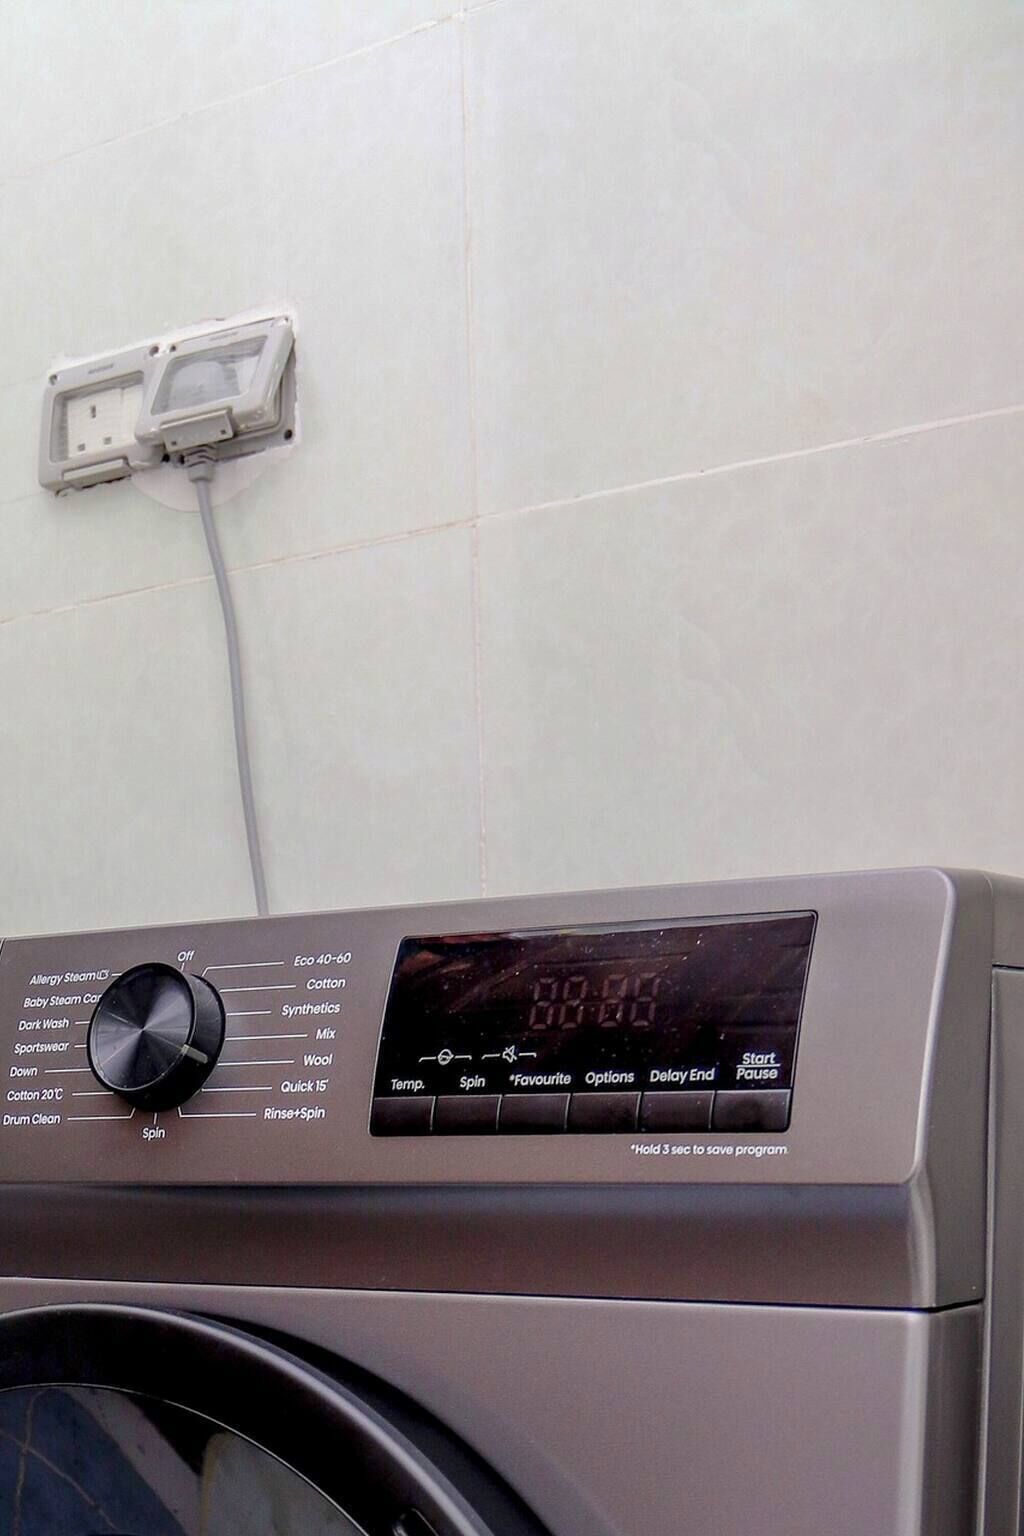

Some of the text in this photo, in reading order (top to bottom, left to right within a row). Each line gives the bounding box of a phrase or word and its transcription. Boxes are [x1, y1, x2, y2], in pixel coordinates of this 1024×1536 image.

[177, 950, 195, 962] Off
[293, 951, 352, 967] Eco 40-60
[29, 971, 96, 986] Allergy Steam
[306, 977, 346, 990] Cotton
[23, 996, 50, 1009] Baby
[49, 995, 82, 1006] Steam
[281, 1002, 341, 1019] Synthetics
[18, 1017, 70, 1031] Dark Wash
[315, 1027, 336, 1040] Mix
[14, 1042, 70, 1056] Sportswear
[303, 1053, 333, 1066] Wool
[742, 1052, 776, 1065] Start
[9, 1066, 38, 1077] Down
[584, 1070, 635, 1087] Options
[649, 1068, 716, 1085] Delay End
[736, 1067, 778, 1081] Pause
[280, 1080, 314, 1093] Quick
[390, 1079, 425, 1092] Temp.
[459, 1075, 486, 1090] Spin
[7, 1090, 40, 1101] Cotton
[3, 1113, 61, 1126] Drum Clean
[263, 1106, 326, 1122] Rinse+Spin
[142, 1126, 166, 1141] Spin
[661, 1144, 670, 1155] 3
[670, 1146, 692, 1155] sec
[692, 1145, 705, 1155] to
[706, 1147, 734, 1155] save
